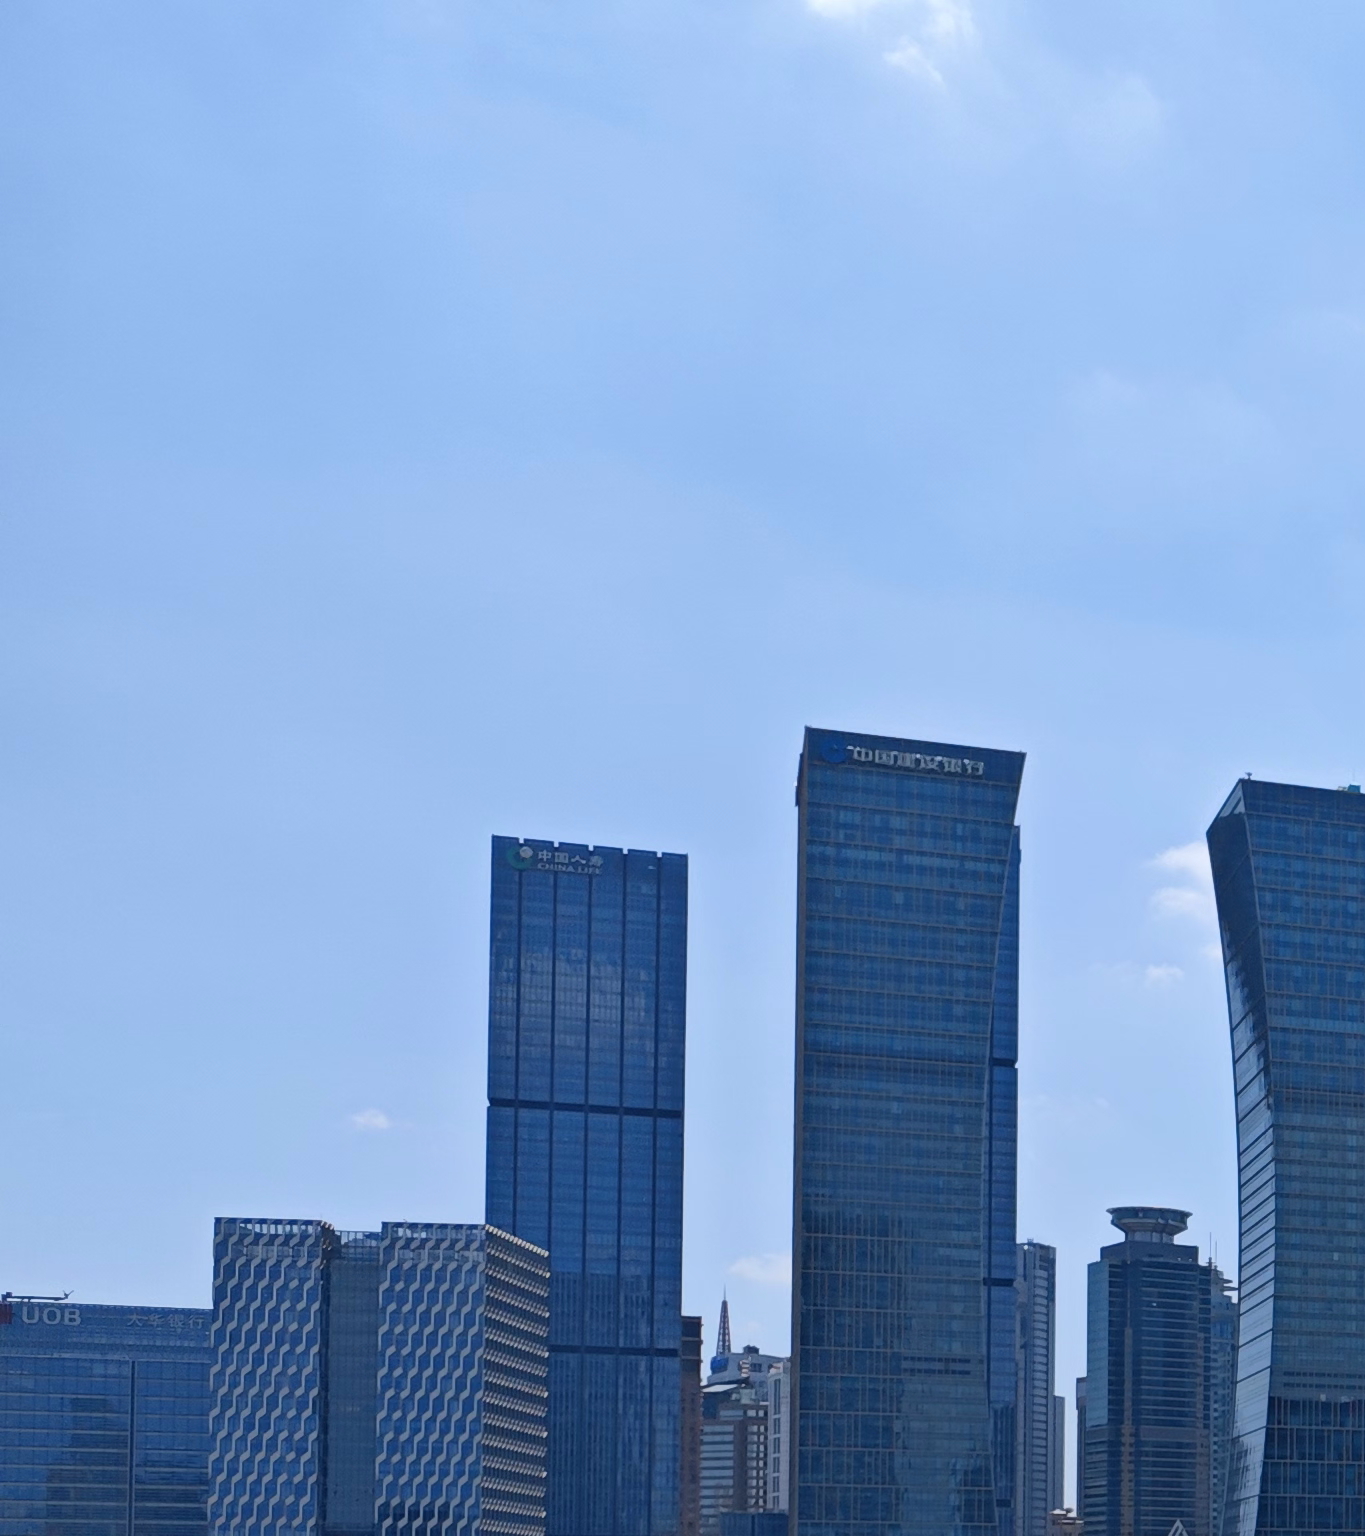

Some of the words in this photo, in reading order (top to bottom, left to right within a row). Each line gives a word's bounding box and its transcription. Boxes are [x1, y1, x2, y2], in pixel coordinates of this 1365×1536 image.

[22, 1306, 81, 1326] UOB
[127, 1313, 205, 1328] 大华银行
